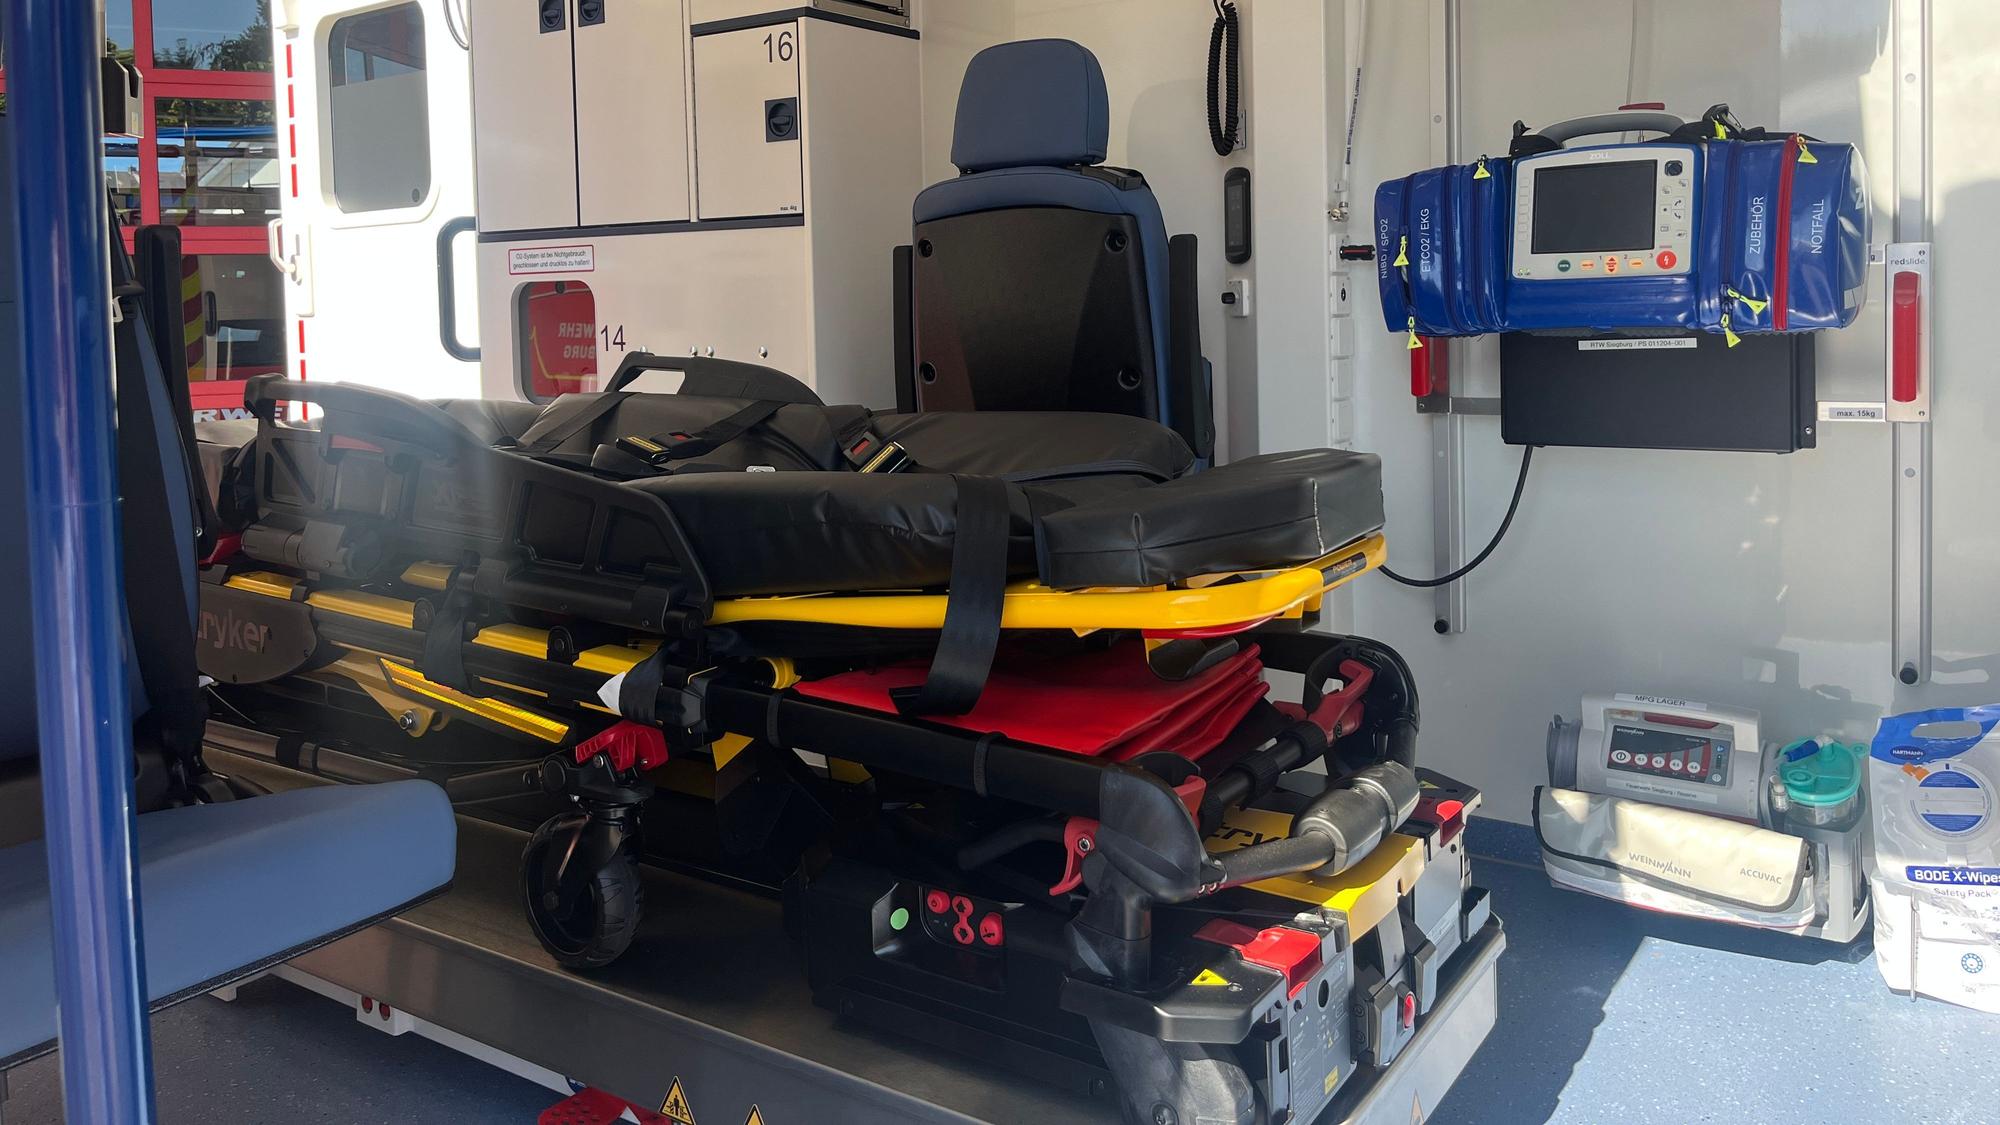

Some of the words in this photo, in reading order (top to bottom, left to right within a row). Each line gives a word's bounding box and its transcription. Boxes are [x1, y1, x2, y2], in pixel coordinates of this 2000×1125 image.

[763, 31, 793, 63] 16
[1380, 218, 1389, 246] SPO2
[1420, 208, 1430, 230] EKG
[1749, 196, 1765, 255] ZUBEHÖR
[1810, 199, 1824, 254] NOTFALL
[1420, 238, 1431, 273] ETCO2
[601, 325, 626, 351] 14
[1857, 410, 1876, 418] 15kg
[1634, 695, 1655, 703] MPG
[1656, 698, 1687, 707] LAGER
[1628, 851, 1692, 879] WEINMANN
[1739, 867, 1784, 885] ACCUVAC
[1914, 869, 1951, 882] BODE
[1933, 887, 1966, 899] Safety
[1968, 889, 1992, 898] Pack
